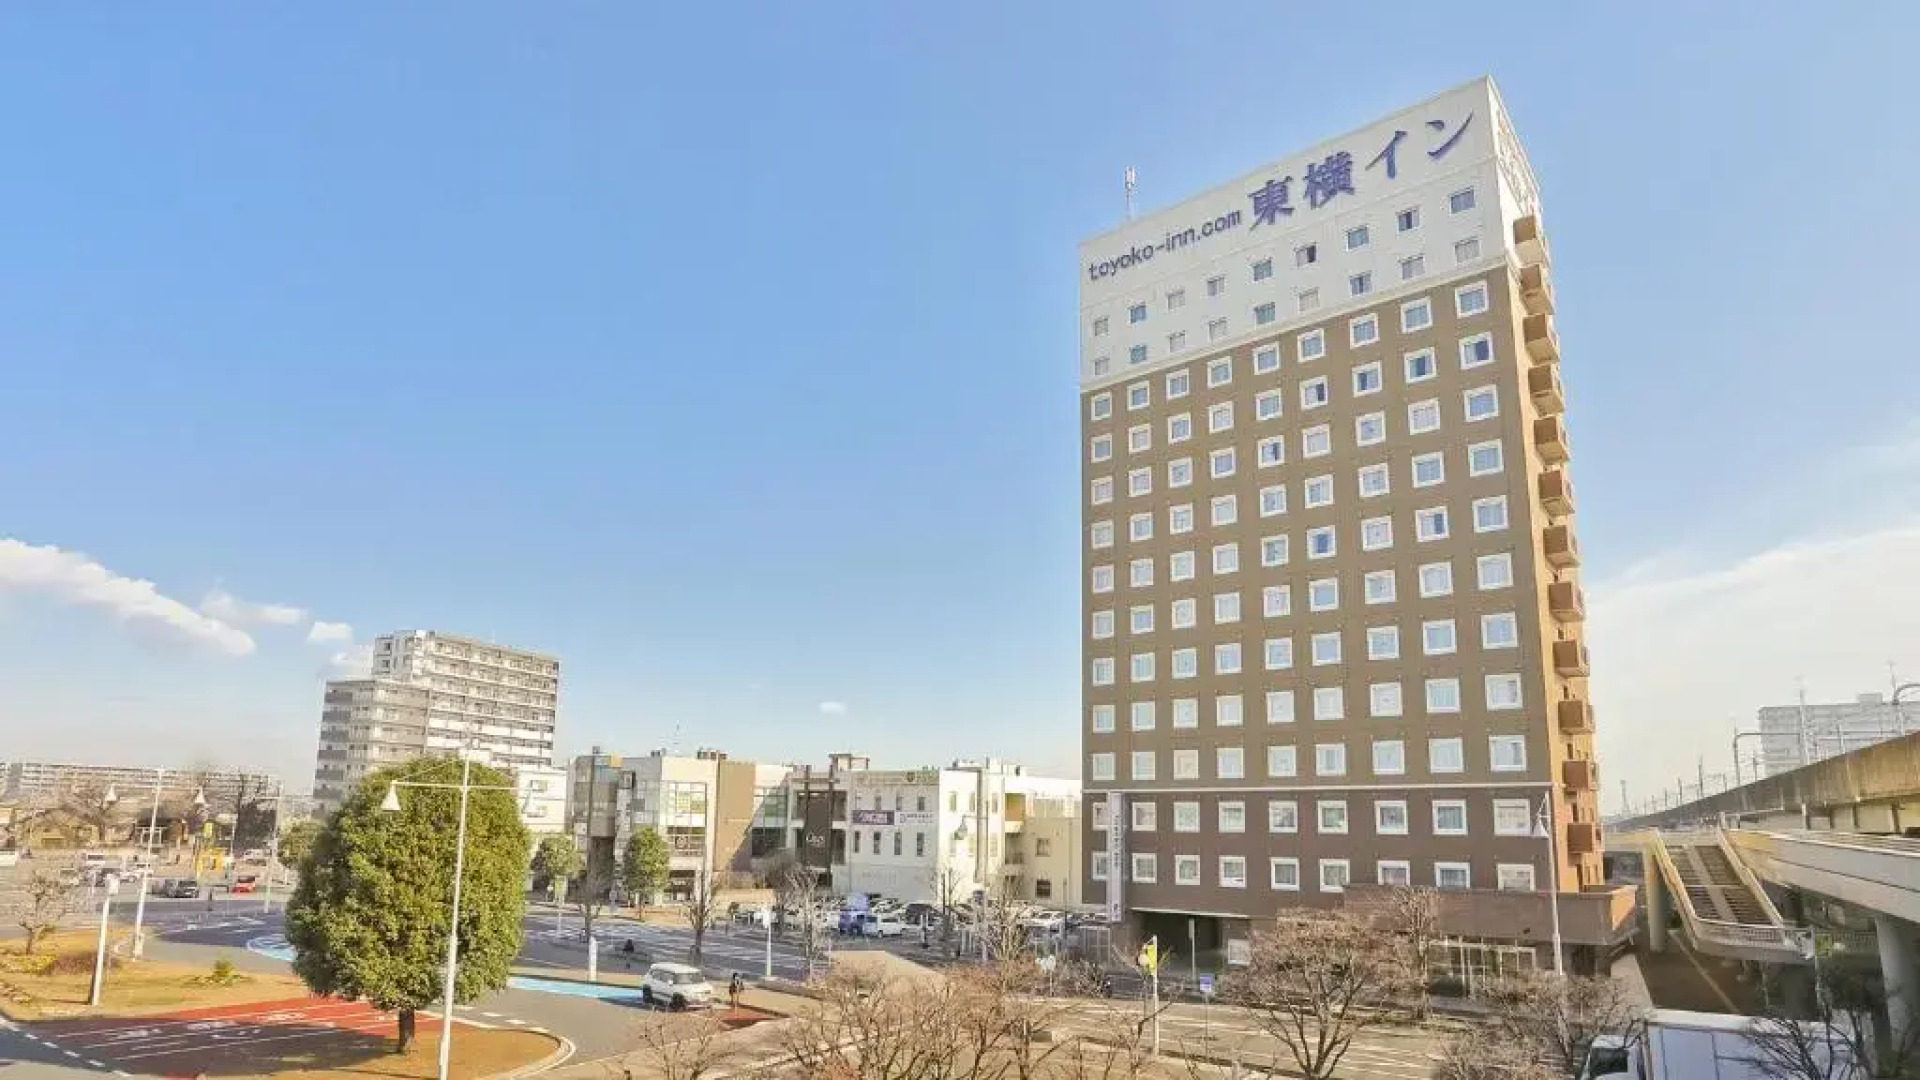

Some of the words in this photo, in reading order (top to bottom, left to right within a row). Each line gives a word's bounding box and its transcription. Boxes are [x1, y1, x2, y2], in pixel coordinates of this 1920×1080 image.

[1247, 110, 1474, 233] 東横イン
[1088, 209, 1242, 281] toyoko-inn.com
